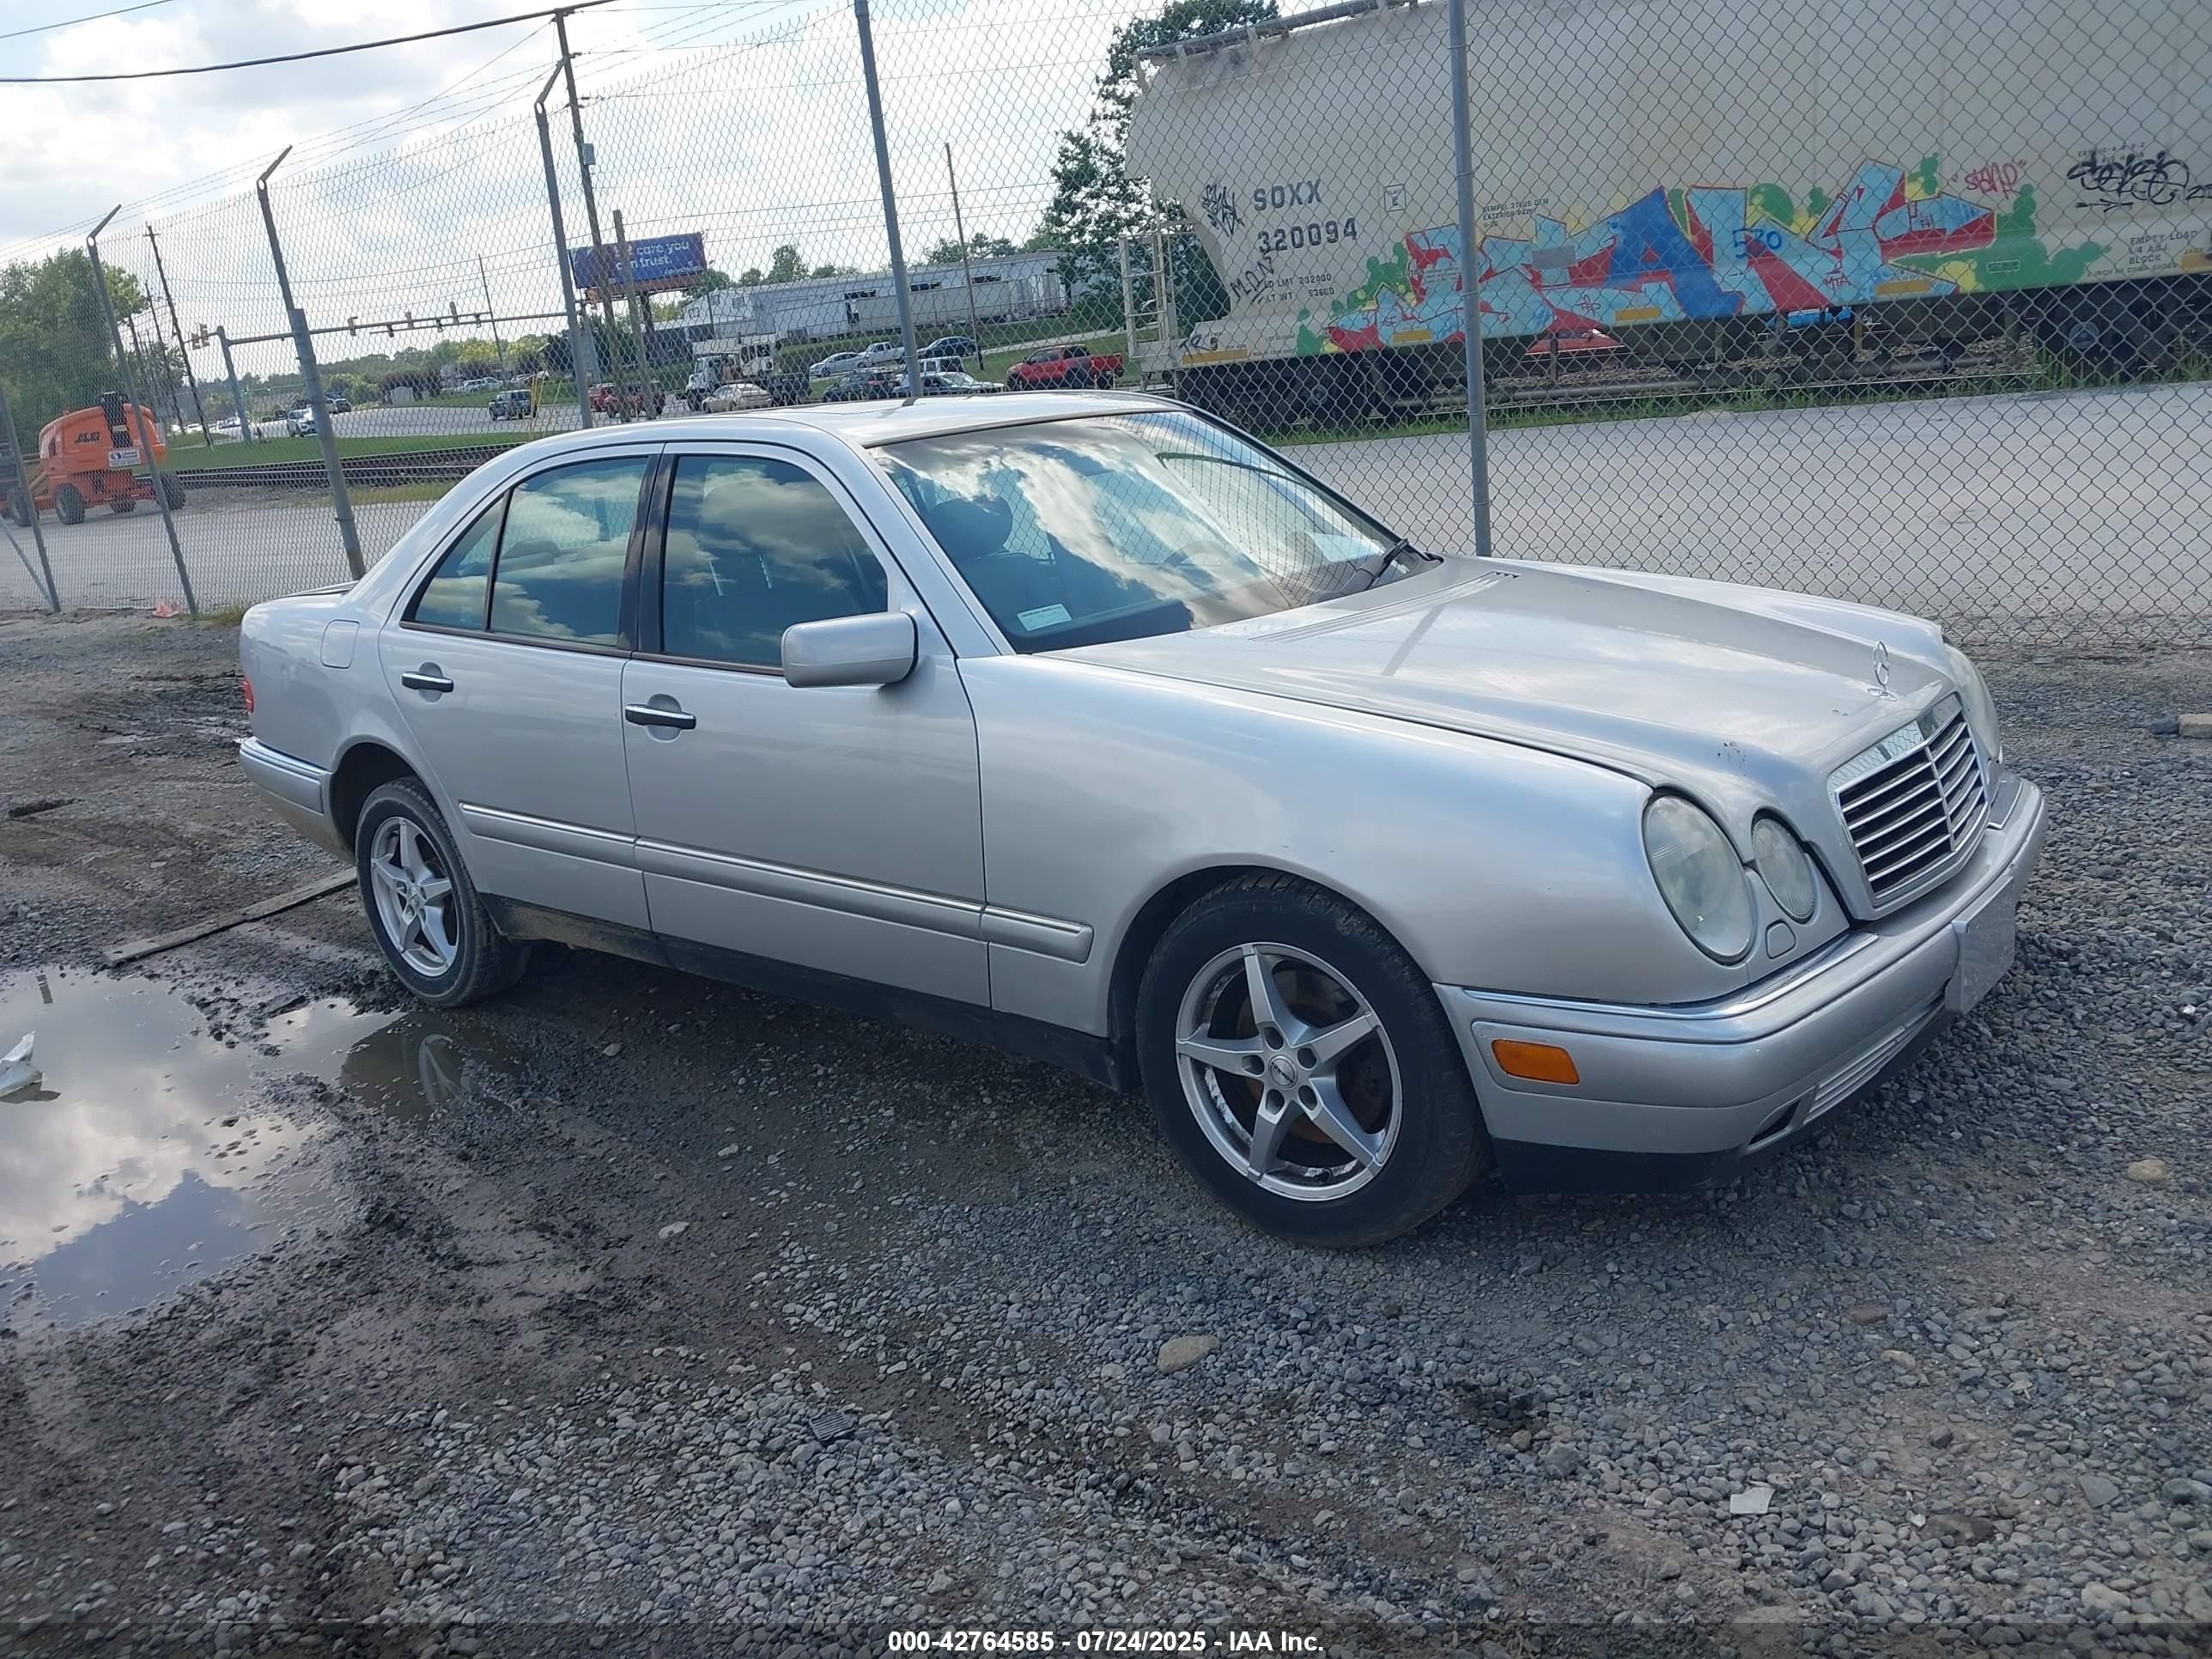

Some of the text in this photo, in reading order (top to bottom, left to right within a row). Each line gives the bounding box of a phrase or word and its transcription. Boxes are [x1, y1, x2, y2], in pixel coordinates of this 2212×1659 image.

[1253, 179, 1321, 212] SOXX
[1257, 217, 1358, 253] 320094
[2130, 230, 2198, 246] EMPTY LOAD
[636, 244, 664, 255] care
[666, 240, 690, 254] you
[616, 257, 639, 271] cn
[2129, 254, 2162, 264] BLOCK
[1278, 277, 1294, 288] LMT
